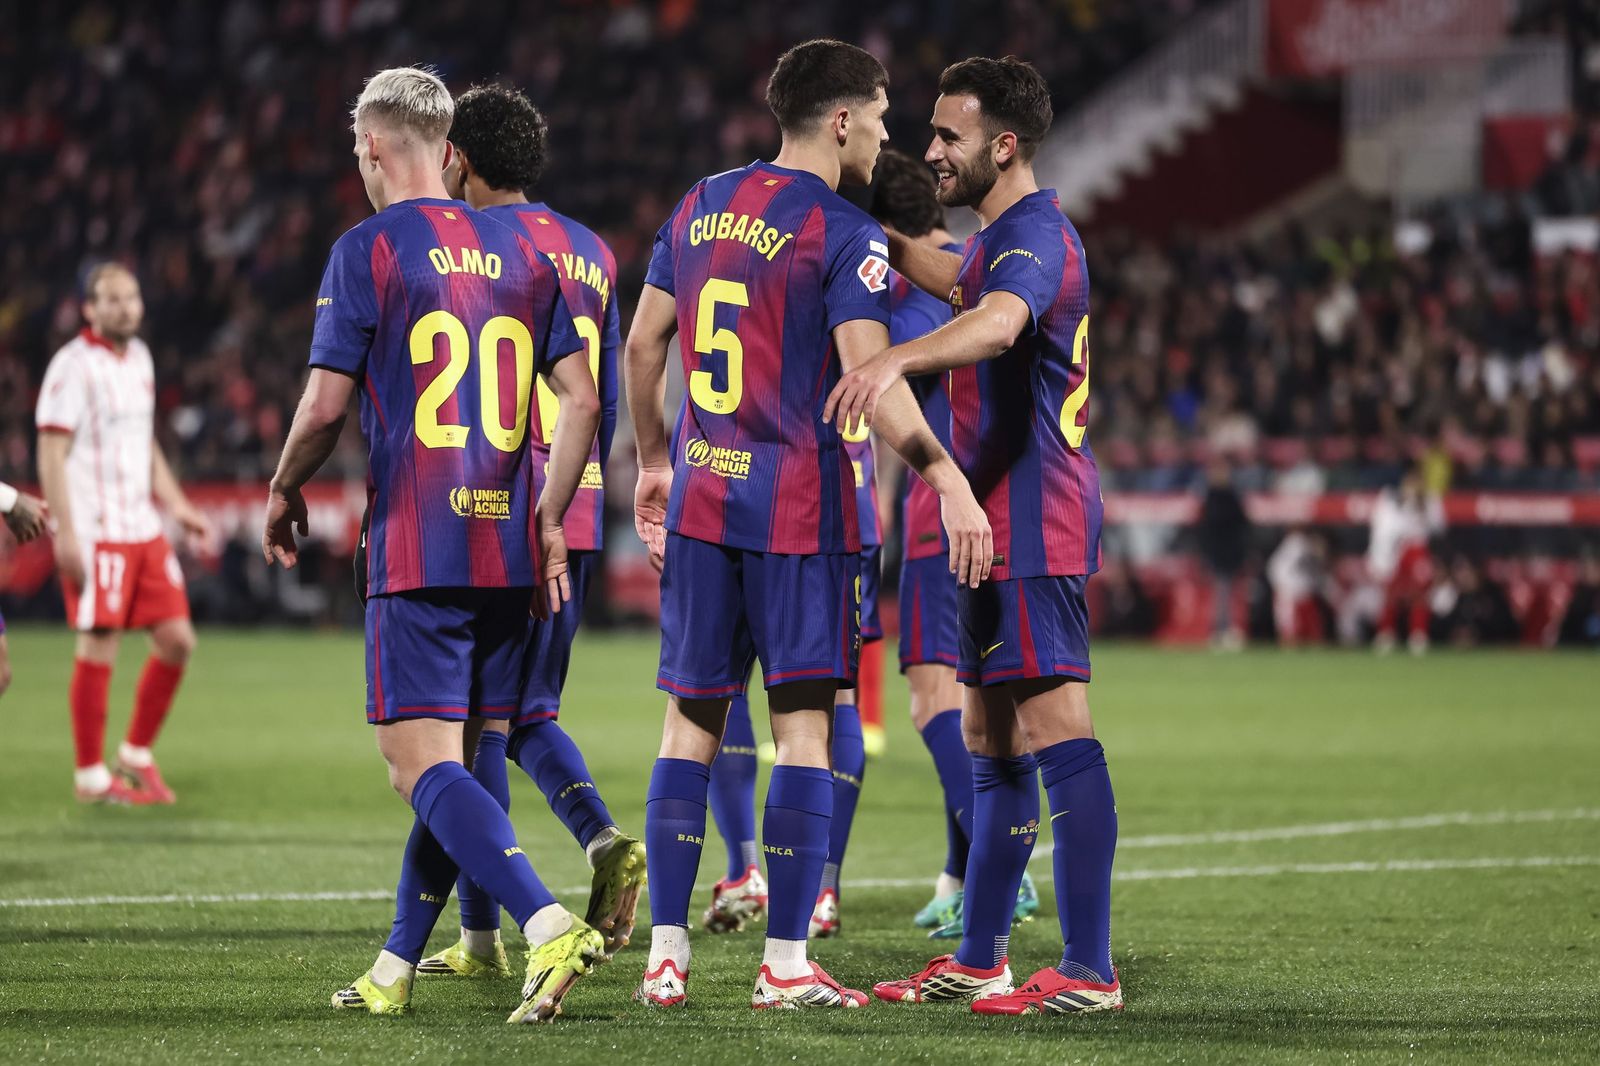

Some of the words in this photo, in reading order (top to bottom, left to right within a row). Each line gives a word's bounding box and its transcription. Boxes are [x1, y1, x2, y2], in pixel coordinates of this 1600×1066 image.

[689, 212, 793, 262] CUBARSÍ
[428, 247, 502, 280] OLMO
[689, 278, 750, 414] 5
[409, 310, 534, 452] 20
[711, 446, 752, 463] NHCR
[473, 489, 510, 502] UNHCR
[474, 502, 510, 514] ACNUR
